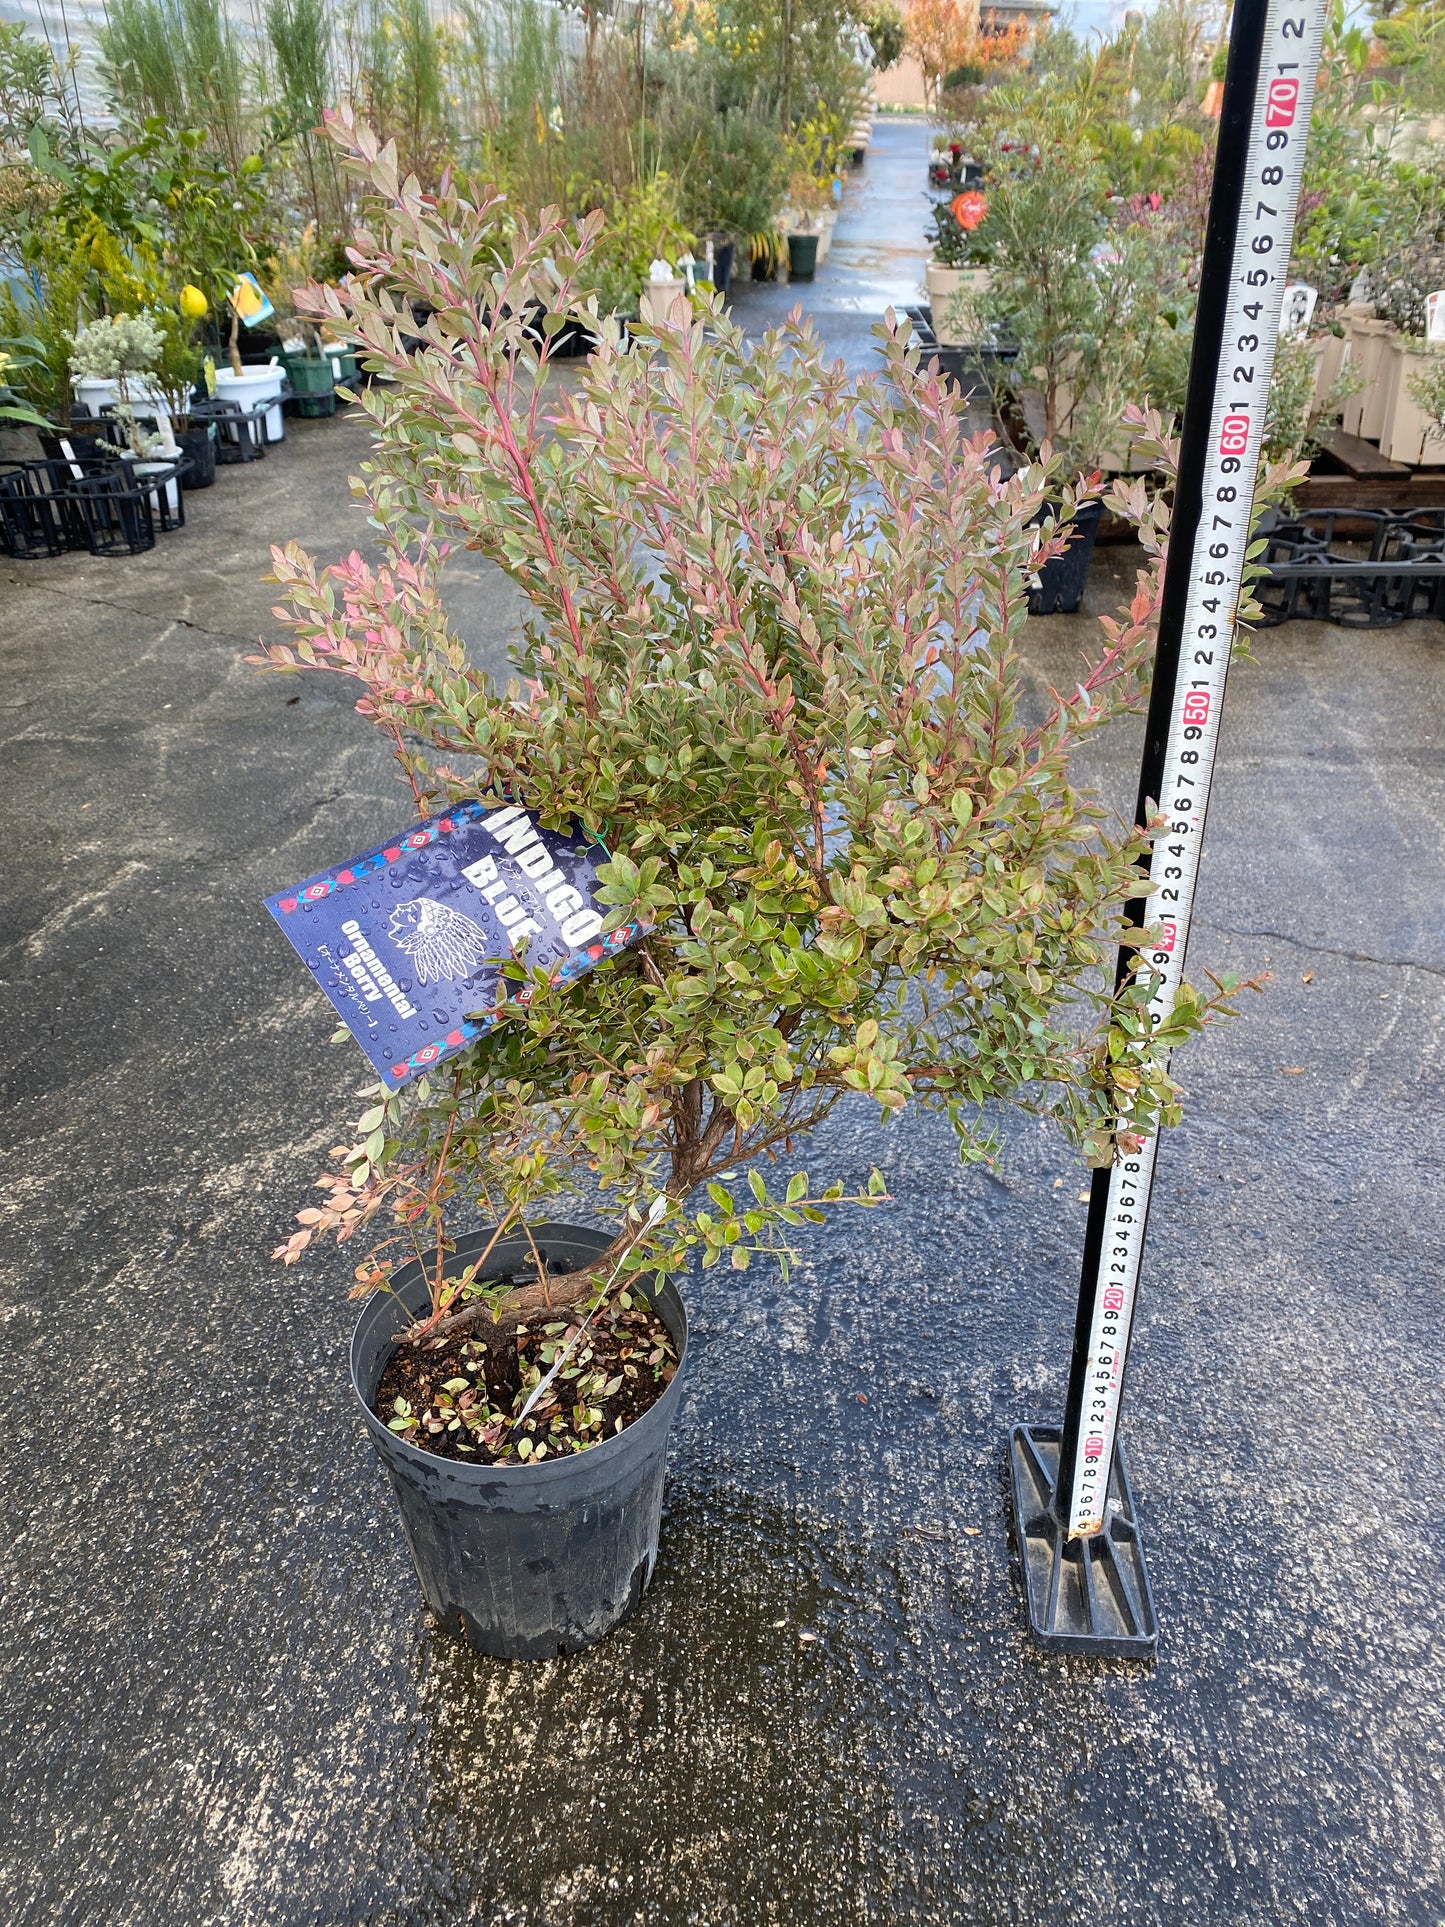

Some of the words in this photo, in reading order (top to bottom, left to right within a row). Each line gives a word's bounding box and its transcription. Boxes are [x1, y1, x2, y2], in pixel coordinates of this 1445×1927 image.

[1282, 18, 1305, 39] 2
[1277, 63, 1299, 75] 1
[1268, 84, 1296, 121] 70
[1267, 131, 1288, 150] 9
[1262, 165, 1283, 185] 8
[1255, 201, 1277, 220] 7
[1252, 235, 1273, 254] 6
[1247, 269, 1268, 287] 5
[1243, 301, 1263, 320] 4
[1238, 334, 1259, 352] 3
[1233, 366, 1254, 383] 2
[1229, 402, 1249, 413] 1
[1222, 419, 1248, 453] 60
[1221, 458, 1240, 474] 9
[1217, 487, 1236, 503] 8
[1213, 515, 1232, 531] 7
[1210, 543, 1228, 558] 6
[1206, 572, 1224, 585] 5
[1202, 598, 1220, 613] 4
[1198, 624, 1216, 639] 3
[1194, 650, 1213, 665] 2
[1191, 680, 1209, 689] 1
[1185, 695, 1208, 723] 50
[1184, 727, 1202, 741] 9
[1180, 750, 1198, 764] 8
[1177, 774, 1195, 787] 7
[1174, 798, 1191, 811] 6
[1172, 822, 1188, 834] 5
[1168, 844, 1185, 857] 4
[480, 804, 604, 948] INDIGO
[1165, 866, 1182, 879] 3
[461, 855, 543, 947] BLUE
[1161, 888, 1179, 902] 2
[1152, 952, 1170, 965] 9
[342, 919, 418, 1020] Ornamental
[342, 952, 383, 1002] Berry
[1124, 1162, 1140, 1173] 8
[1122, 1179, 1137, 1189] 7
[1120, 1197, 1135, 1207] 6
[1117, 1213, 1133, 1224] 5
[1116, 1231, 1130, 1241] 4
[1113, 1247, 1128, 1257] 3
[1111, 1263, 1126, 1274] 2
[1105, 1290, 1122, 1309] 20
[1104, 1311, 1119, 1320] 9
[1102, 1326, 1116, 1335] 8
[1100, 1341, 1114, 1350] 7
[1098, 1356, 1112, 1365] 6
[1097, 1371, 1110, 1380] 5
[1095, 1386, 1108, 1395] 4
[1093, 1400, 1106, 1409] 3
[1090, 1414, 1104, 1423] 2
[1086, 1439, 1102, 1455] 10
[1085, 1455, 1099, 1464] 9
[1084, 1469, 1097, 1477] 8
[1082, 1483, 1095, 1491] 7
[1081, 1495, 1094, 1504] 6
[1079, 1509, 1092, 1517] 5
[1077, 1522, 1091, 1530] 4
